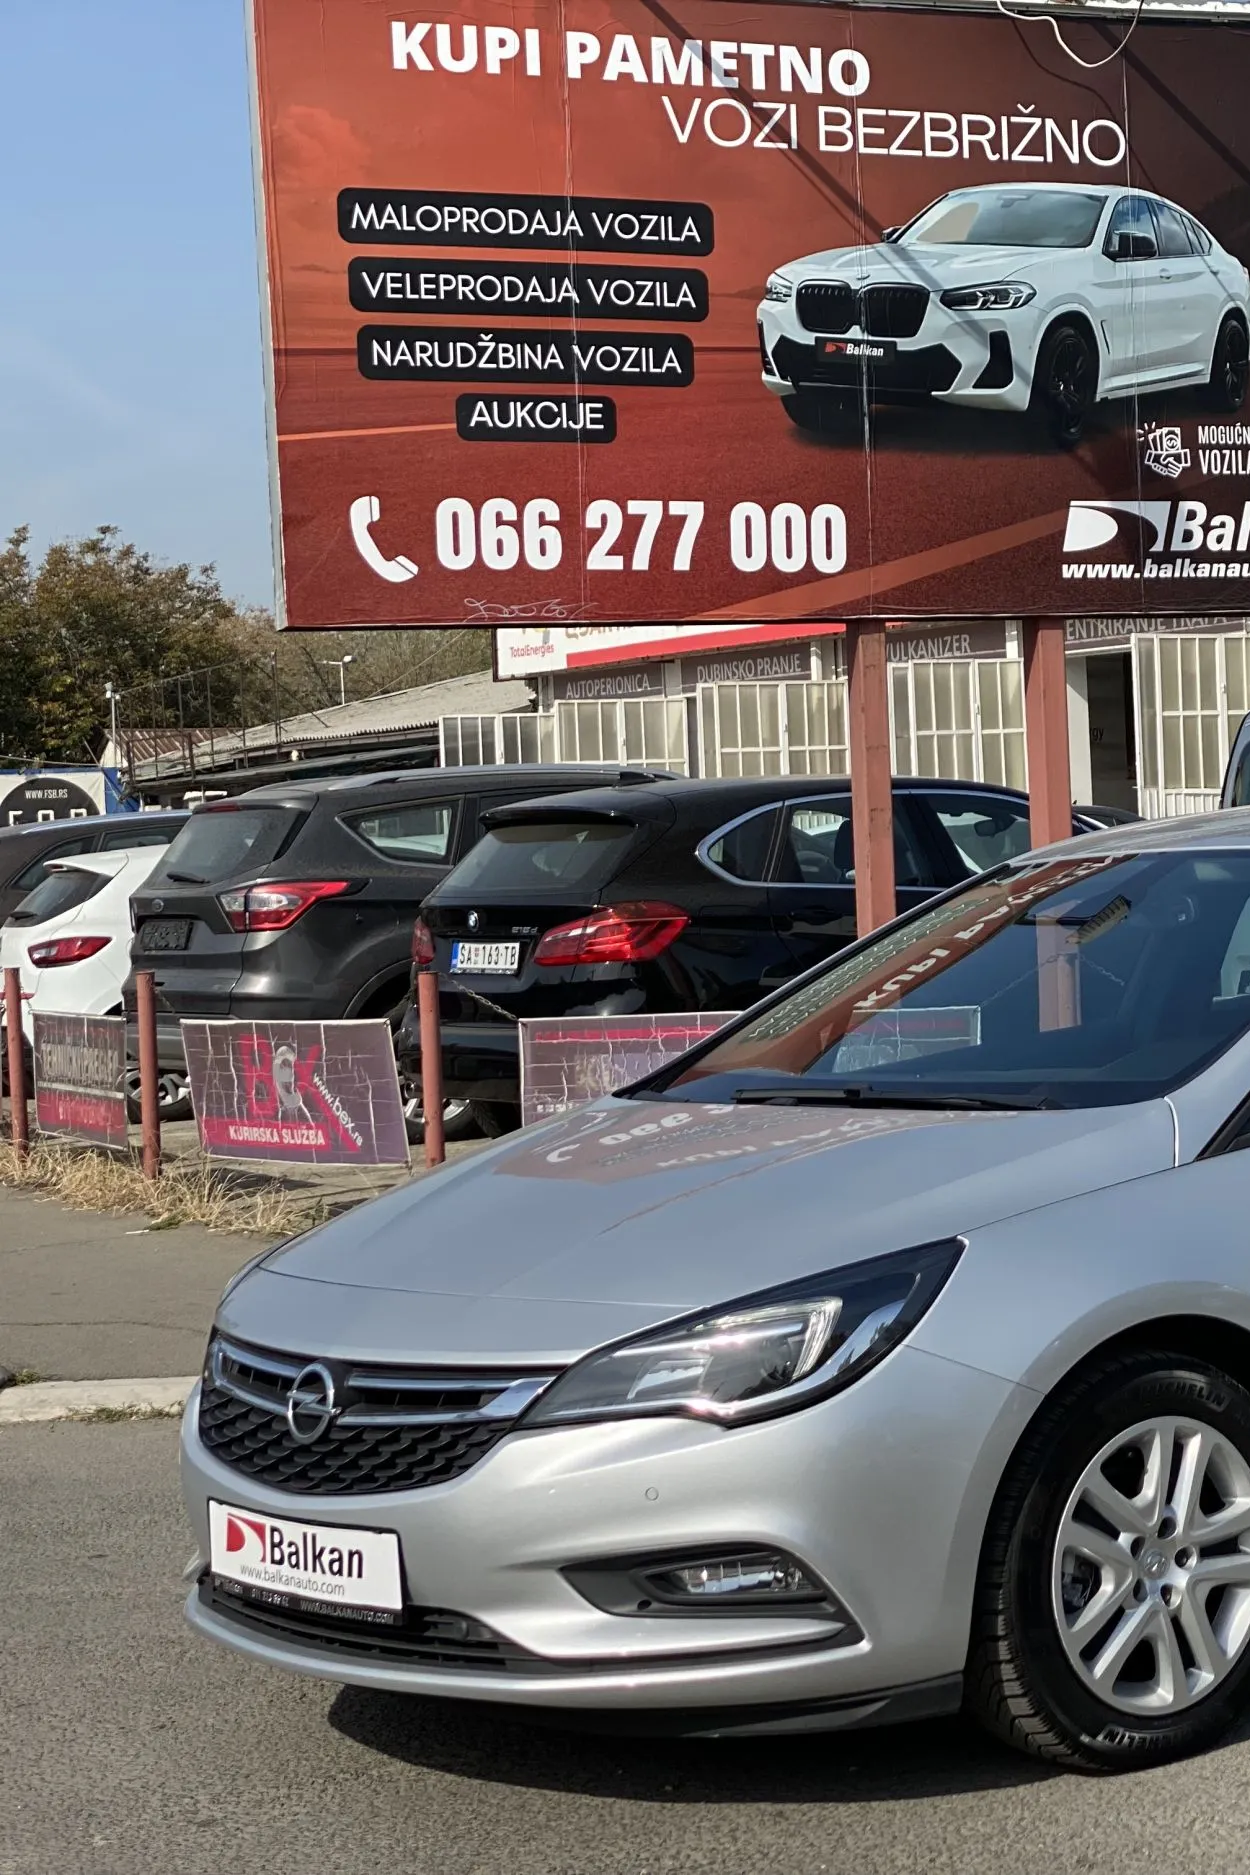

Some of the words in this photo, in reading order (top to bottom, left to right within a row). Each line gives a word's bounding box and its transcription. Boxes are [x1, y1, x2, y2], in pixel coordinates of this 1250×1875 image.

[391, 21, 542, 77] KUPI
[566, 30, 871, 97] PAMETNO
[661, 95, 798, 150] VOZI
[818, 102, 1127, 168] BEZBRIŽNO
[351, 203, 583, 238] MALOPRODAJA
[591, 212, 701, 243] VOZILA
[361, 271, 579, 305] VELEPRODAJA
[586, 279, 696, 309] VOZILA
[372, 333, 564, 371] NARUDŽBINA
[573, 344, 682, 375] VOZILA
[846, 343, 884, 357] Balkan
[469, 400, 604, 430] AUKCIJE
[435, 496, 564, 571] 066
[585, 499, 705, 571] 277
[729, 501, 848, 574] 000
[509, 643, 555, 658] TotalEnergies
[697, 659, 755, 683] DUBINSKO
[757, 653, 802, 676] PRANJE
[565, 673, 650, 699] AUTOPERIONICA
[24, 788, 68, 800] WWW.FSB.RS
[460, 943, 472, 965] SA
[228, 1124, 280, 1143] KURIRSKA
[281, 1123, 326, 1146] SLUŽBA
[269, 1525, 364, 1579] Balkan
[240, 1563, 345, 1597] www.balkanauto.com
